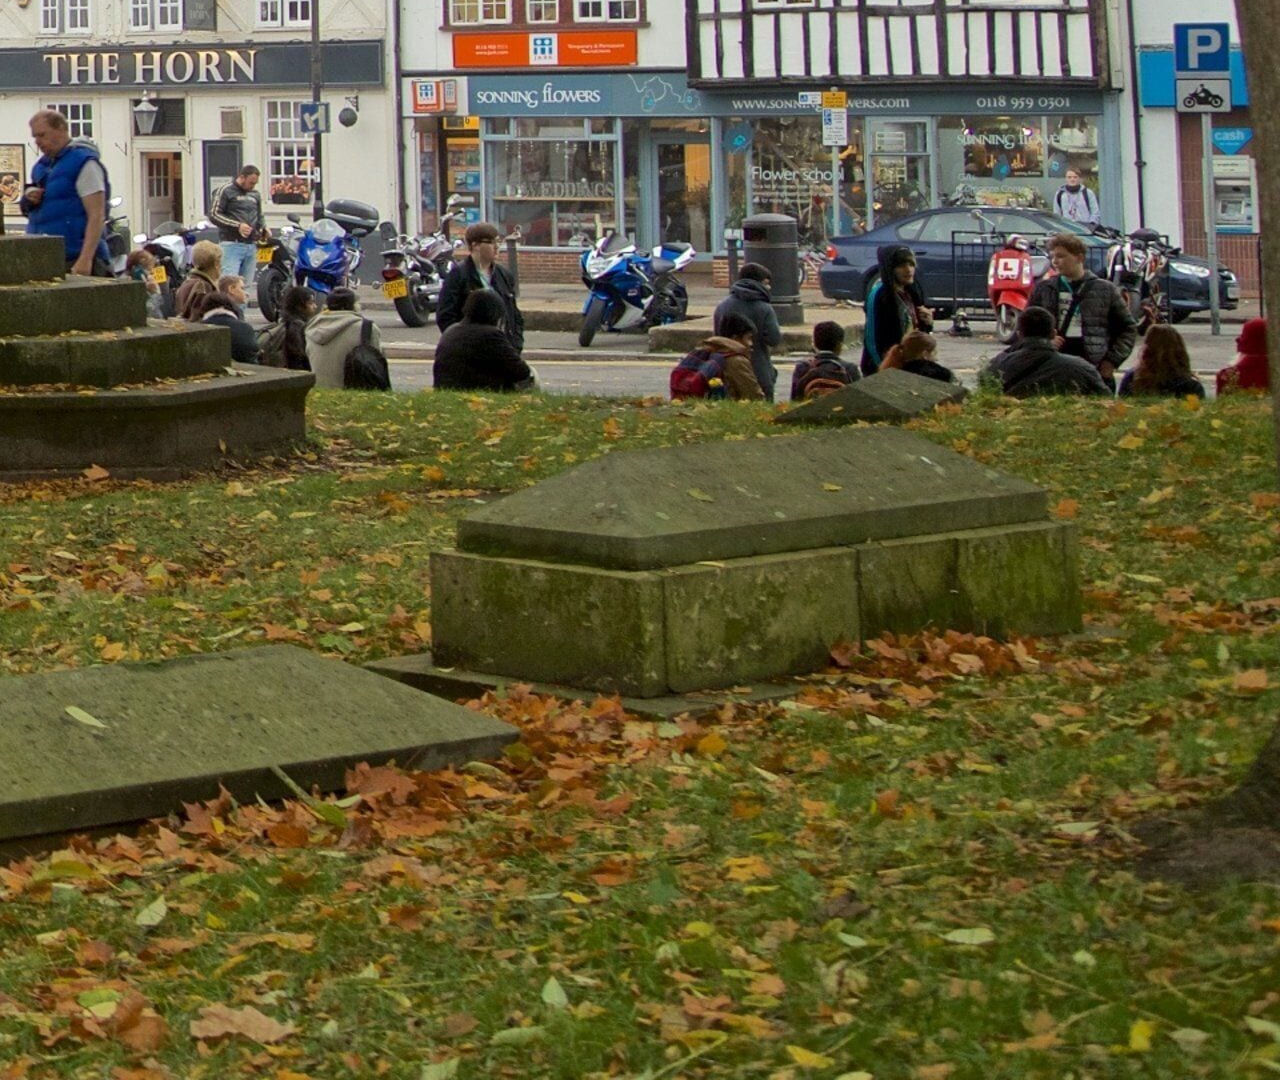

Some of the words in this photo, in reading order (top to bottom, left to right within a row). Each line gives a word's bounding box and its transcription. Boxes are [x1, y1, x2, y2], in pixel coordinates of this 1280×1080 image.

[1187, 28, 1222, 69] P
[43, 52, 120, 85] THE
[133, 49, 257, 84] HORN
[976, 95, 1007, 108] 0118
[1010, 97, 1034, 109] 959
[1214, 129, 1245, 141] cash
[751, 166, 799, 181] Flower
[1003, 261, 1013, 271] L
